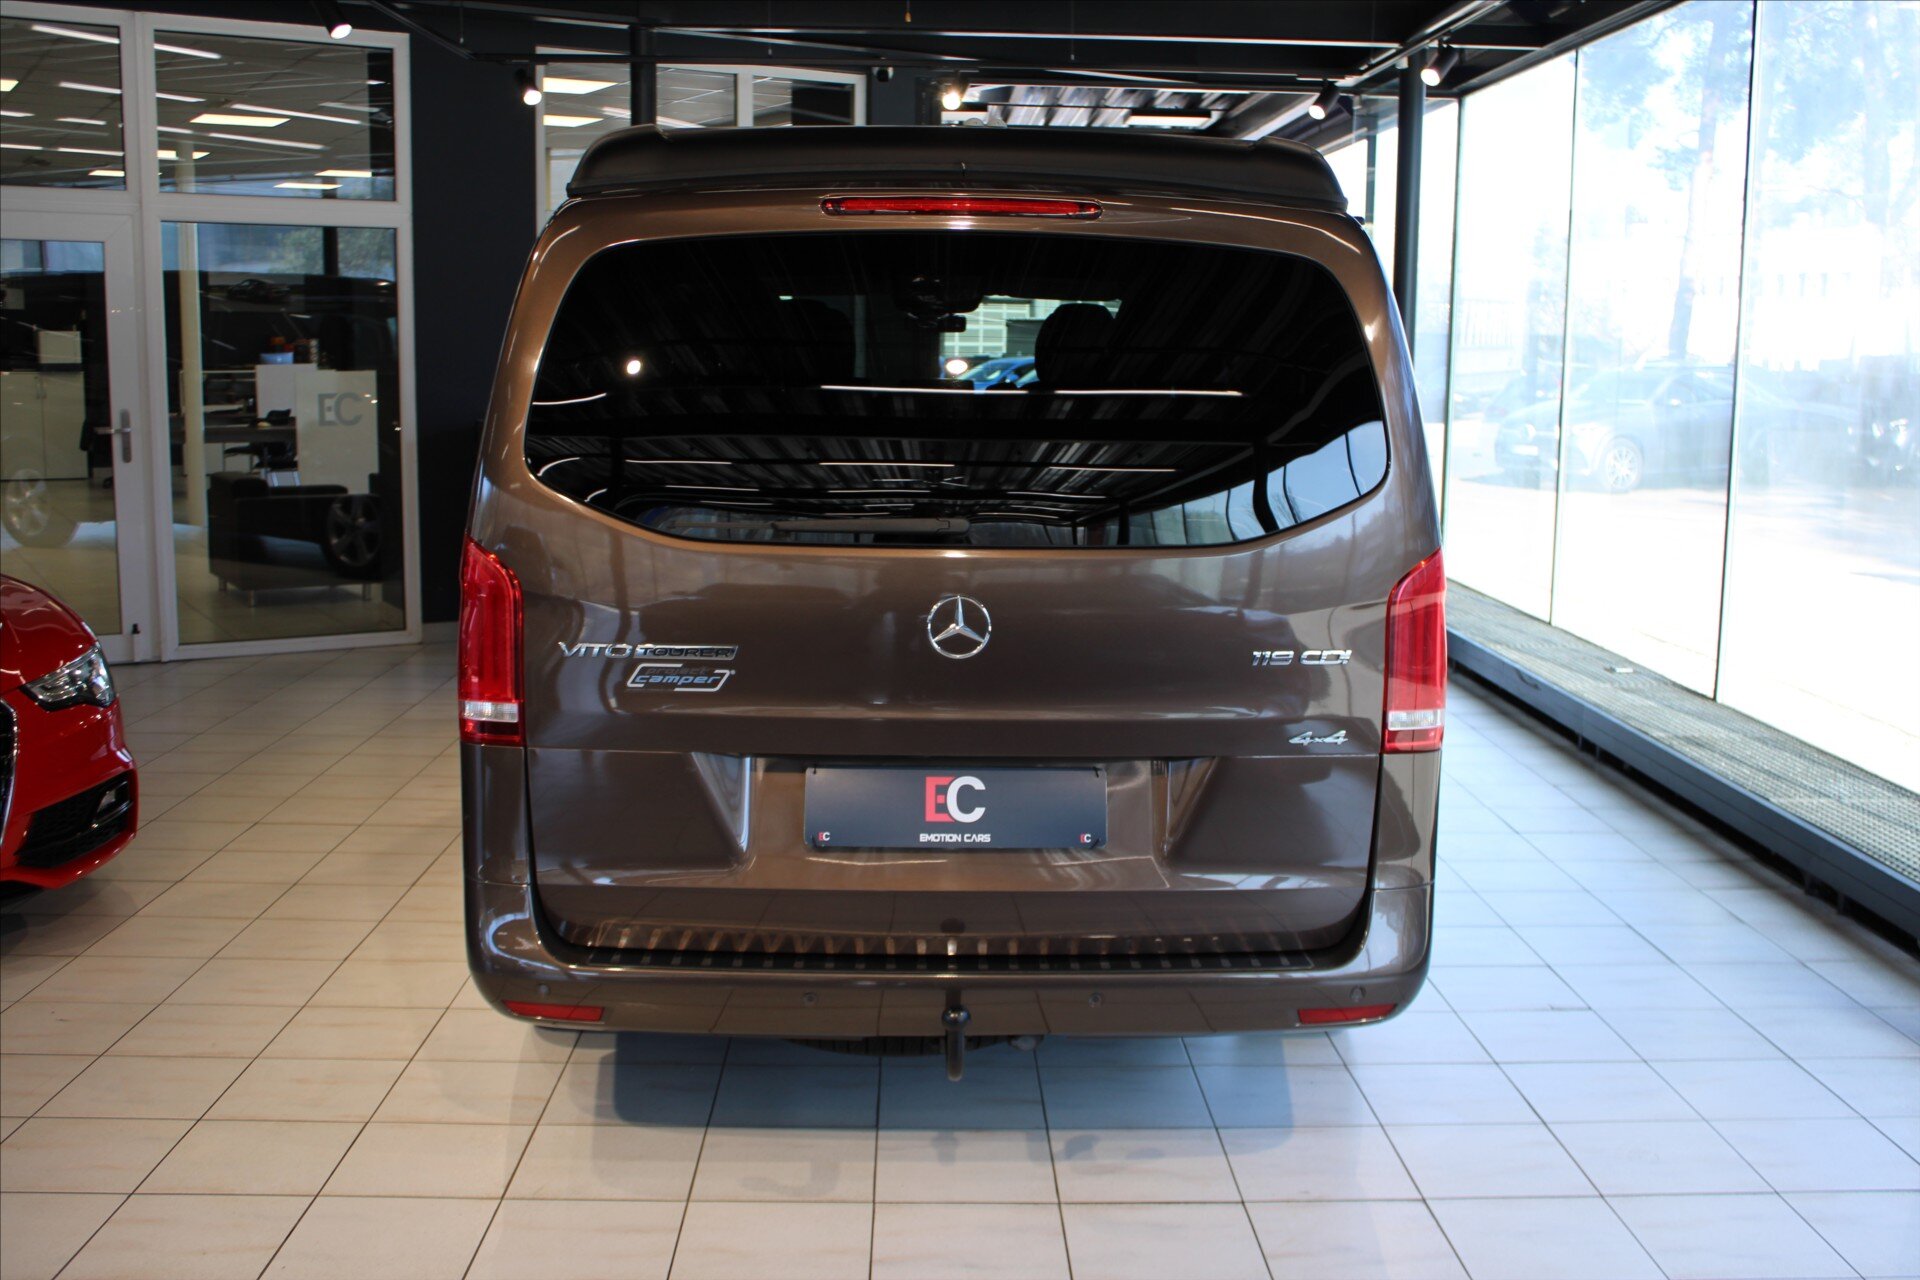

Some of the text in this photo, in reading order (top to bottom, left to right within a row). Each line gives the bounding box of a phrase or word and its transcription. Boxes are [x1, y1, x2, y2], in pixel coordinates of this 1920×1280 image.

[317, 392, 364, 427] EC
[558, 641, 734, 660] VITO TOURER
[1252, 649, 1353, 666] 119 CDI
[634, 674, 722, 686] camper
[1288, 729, 1349, 746] 4x4
[924, 775, 987, 824] EC
[818, 831, 831, 842] EC
[919, 833, 992, 843] EMOTION CARS
[1080, 833, 1092, 843] EC
